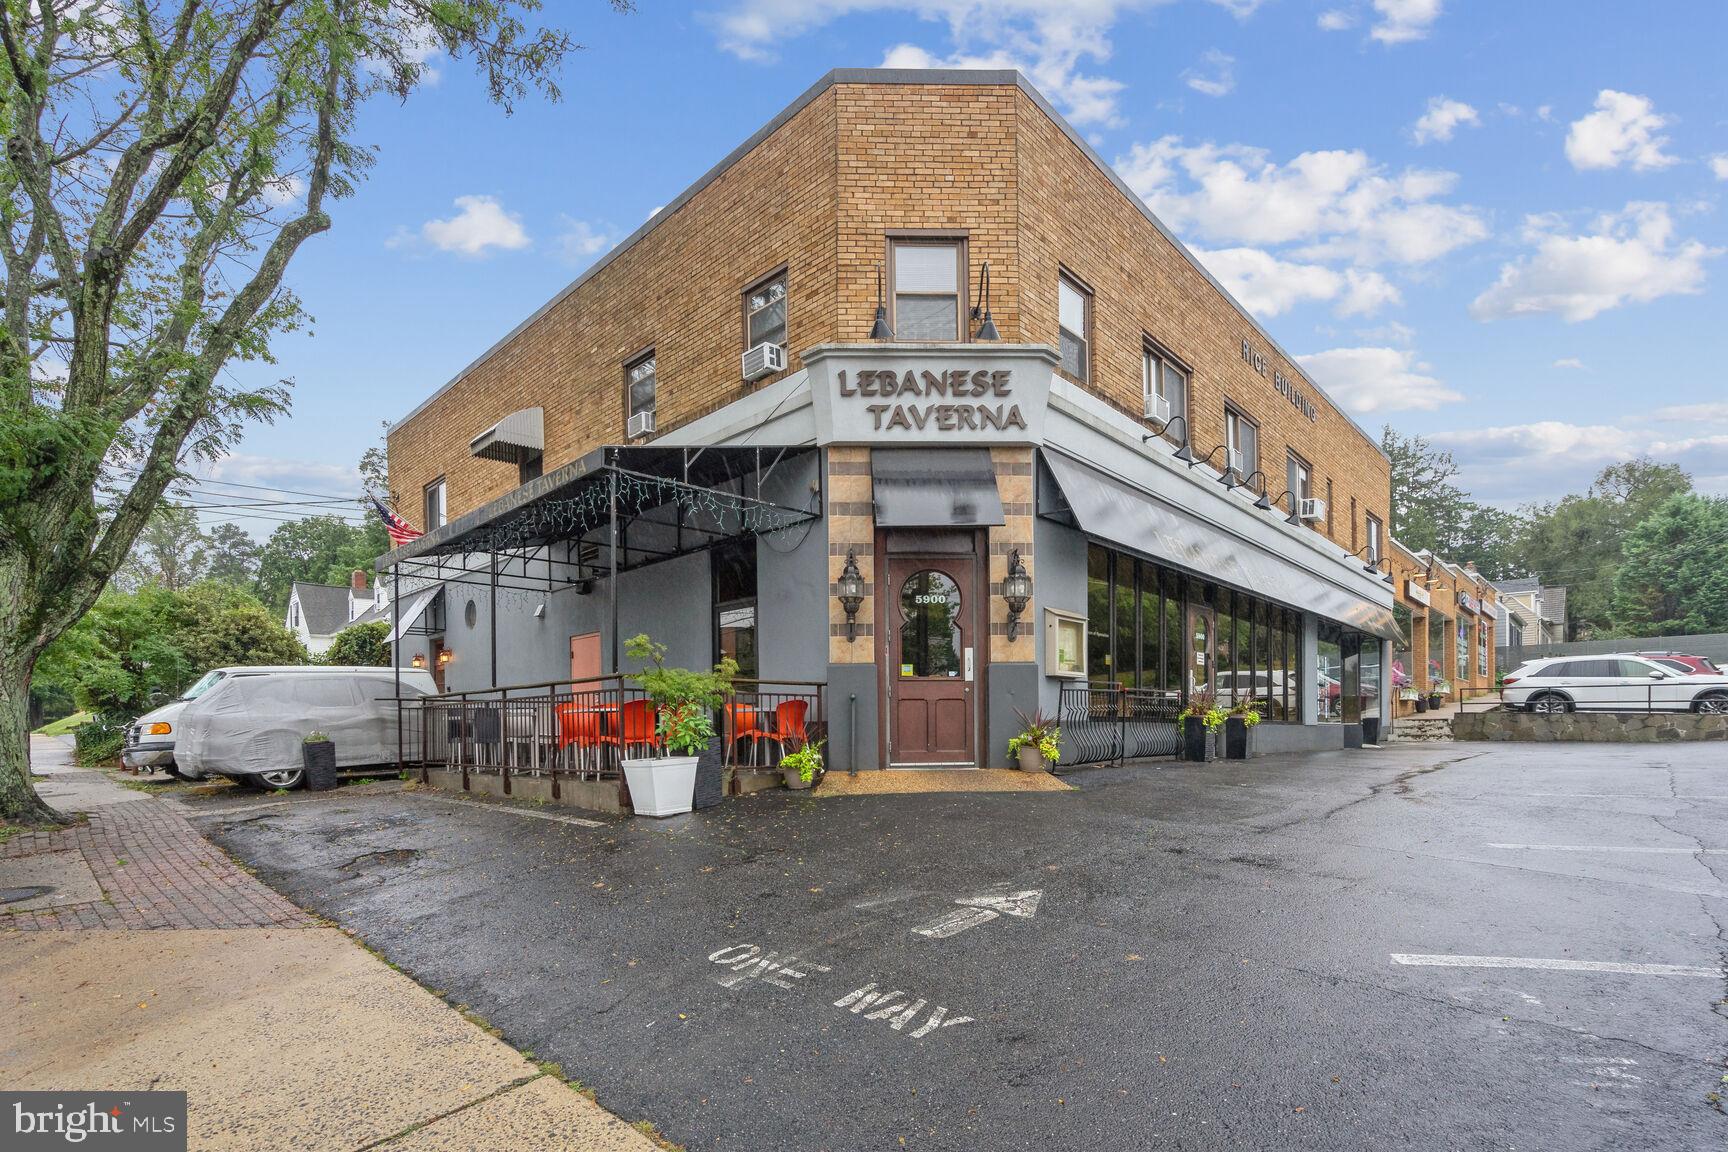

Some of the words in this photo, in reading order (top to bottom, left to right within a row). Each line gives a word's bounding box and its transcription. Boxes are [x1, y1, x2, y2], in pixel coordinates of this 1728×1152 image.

[837, 368, 1013, 398] LEBANESE
[1241, 339, 1267, 379] RICE
[1274, 370, 1316, 423] BUILDING
[865, 403, 1028, 431] TAVERNA
[915, 594, 946, 604] 5900
[708, 943, 832, 990] ONE
[833, 982, 975, 1040] WAY
